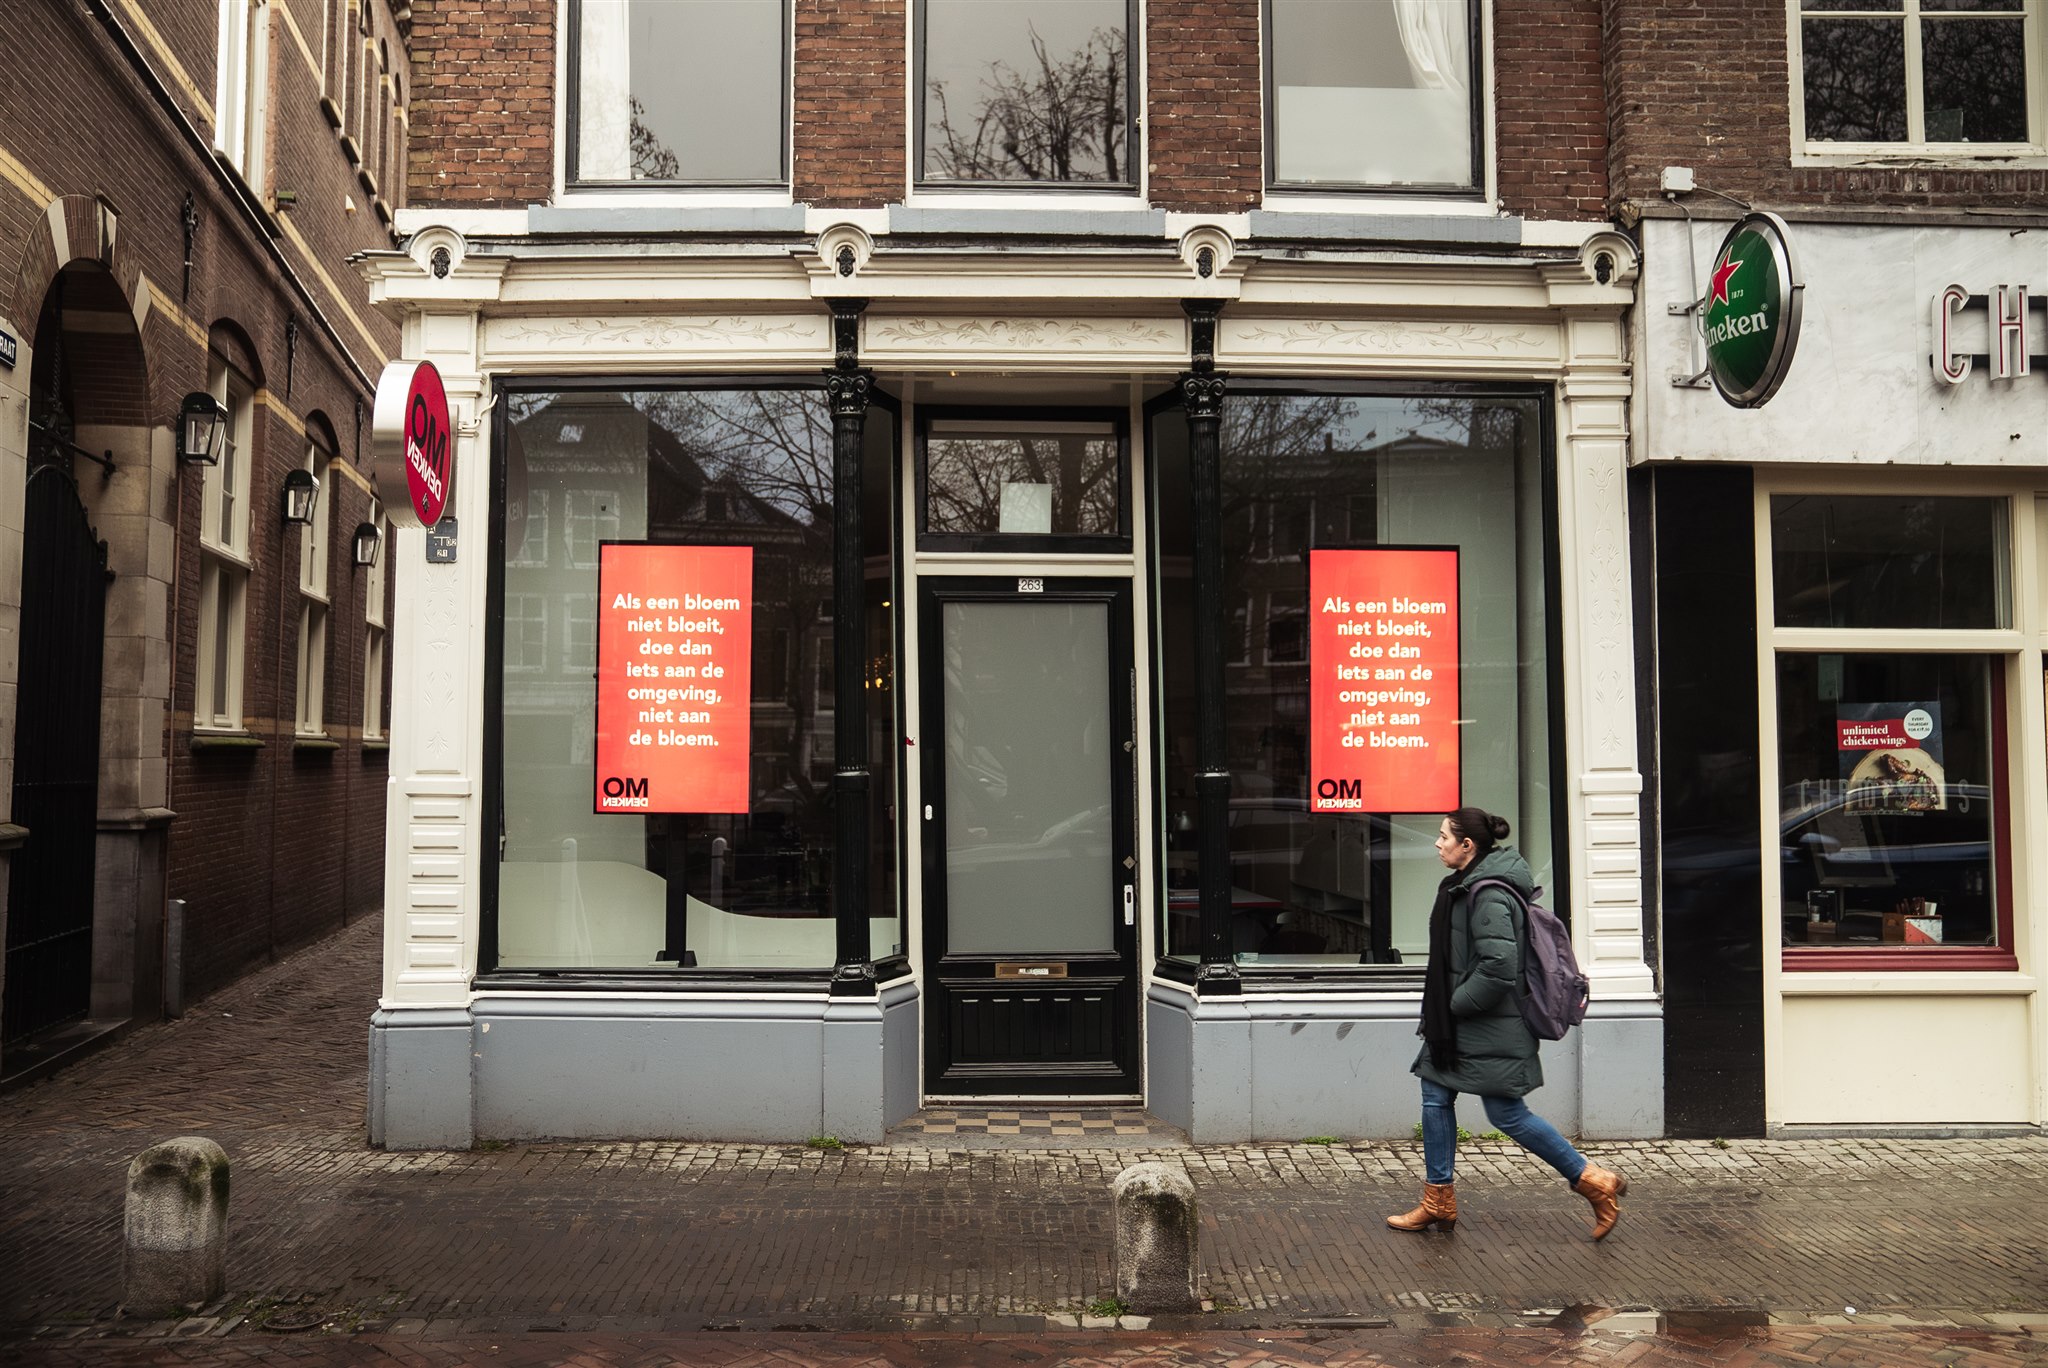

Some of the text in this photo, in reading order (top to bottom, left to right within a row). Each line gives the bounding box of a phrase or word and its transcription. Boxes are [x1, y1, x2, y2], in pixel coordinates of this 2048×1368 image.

[1731, 288, 1744, 299] 1873
[412, 394, 446, 477] OM
[1021, 579, 1041, 590] 263
[612, 593, 740, 610] Als een bloem
[1322, 597, 1446, 613] Als een bloem
[628, 616, 724, 634] niet bloeit,
[1338, 620, 1432, 637] niet bloeit,
[639, 639, 712, 655] doe dan
[1349, 642, 1420, 658] doe dan
[627, 662, 724, 678] iets aan de
[1338, 664, 1433, 680] iets aan de
[627, 685, 722, 705] omgeving,
[1339, 687, 1431, 707] omgeving,
[639, 707, 710, 724] niet aan
[1350, 710, 1420, 726] niet aan
[629, 729, 719, 746] de bloem.
[1843, 725, 1888, 735] unlimited
[1342, 731, 1429, 748] de bloem.
[1843, 735, 1906, 748] chicken wings
[603, 777, 648, 797] OM
[1317, 779, 1361, 799] OM
